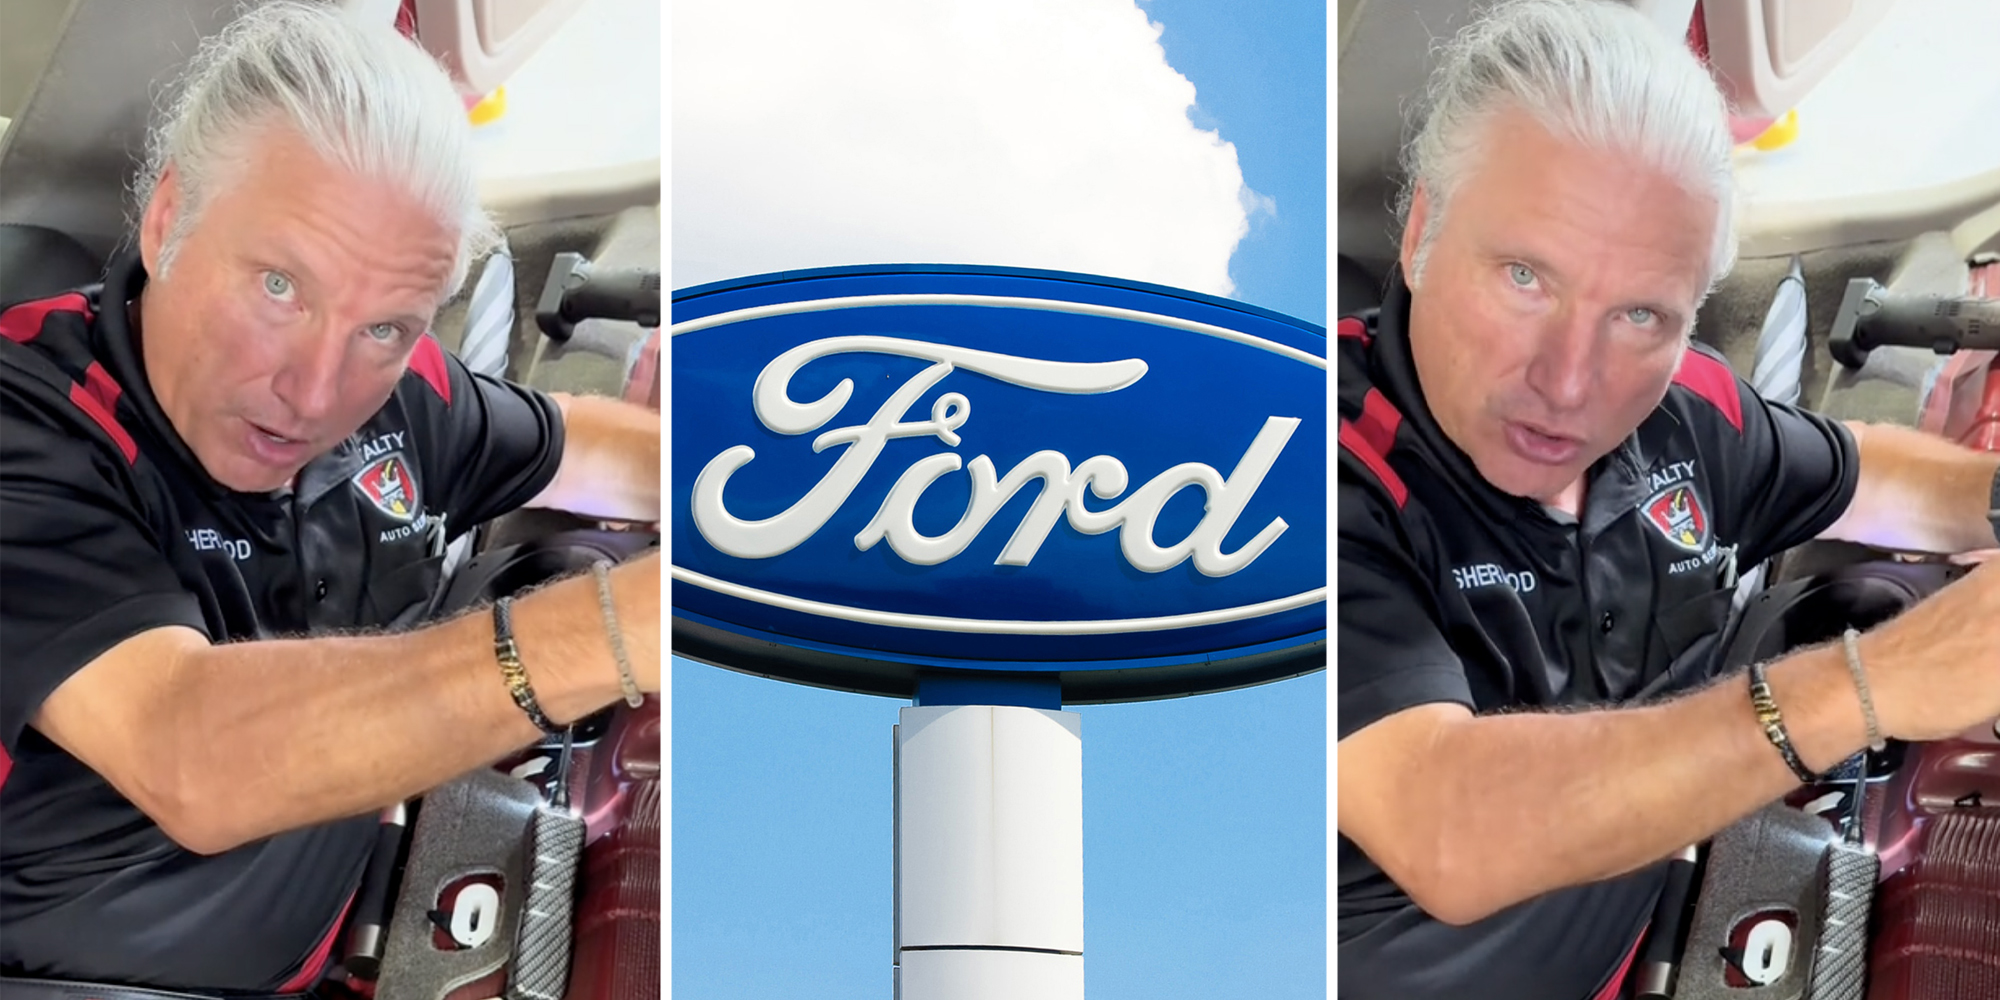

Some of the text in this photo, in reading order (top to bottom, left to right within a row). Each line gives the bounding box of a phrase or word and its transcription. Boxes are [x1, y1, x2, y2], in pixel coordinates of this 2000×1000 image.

[360, 431, 404, 461] ALTY
[692, 335, 1302, 577] Ford
[380, 526, 410, 542] AUTO
[1669, 558, 1700, 574] AUTO
